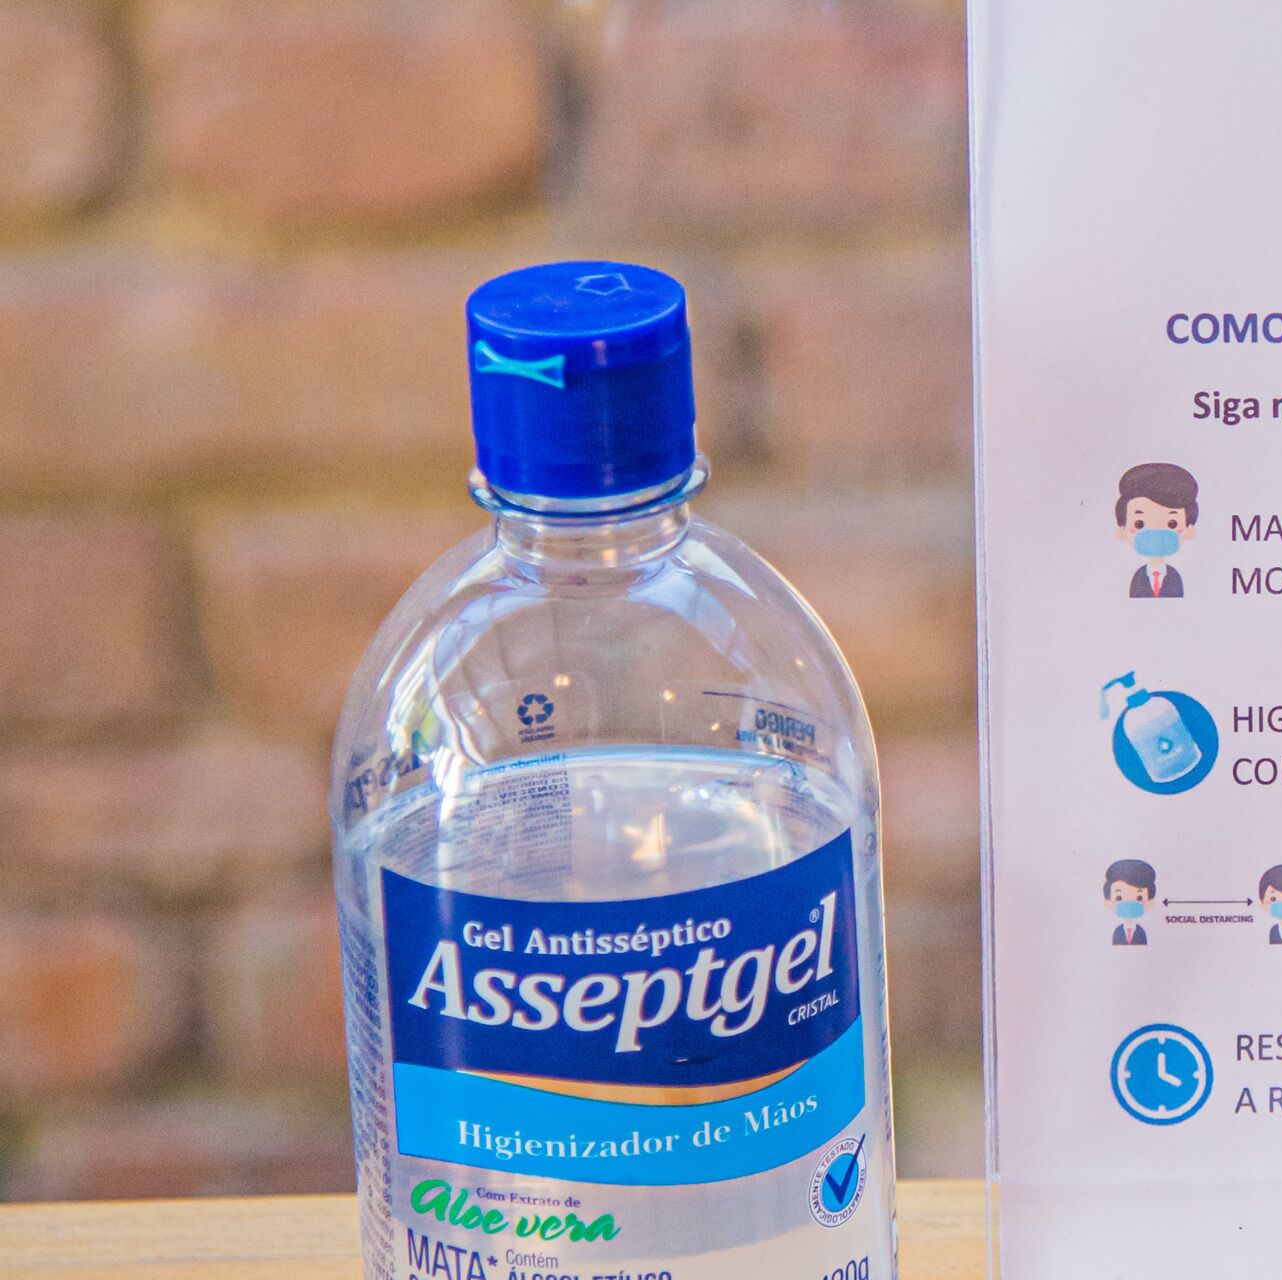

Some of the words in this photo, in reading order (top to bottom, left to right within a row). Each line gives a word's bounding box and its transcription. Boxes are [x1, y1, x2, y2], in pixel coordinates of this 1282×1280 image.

[1193, 391, 1260, 425] Siga
[463, 921, 513, 952] Gel
[524, 918, 731, 957] Antisséptico
[788, 989, 839, 1026] CRISTAL
[1235, 1087, 1257, 1114] A
[458, 1120, 680, 1161] Higienizador
[693, 1121, 731, 1147] de
[743, 1094, 818, 1137] Mãos
[822, 1141, 856, 1171] TESTADO
[476, 1187, 505, 1201] Com
[510, 1193, 560, 1208] Extrato
[564, 1197, 581, 1208] de
[516, 1214, 621, 1242] vera
[506, 1249, 558, 1269] Contém
